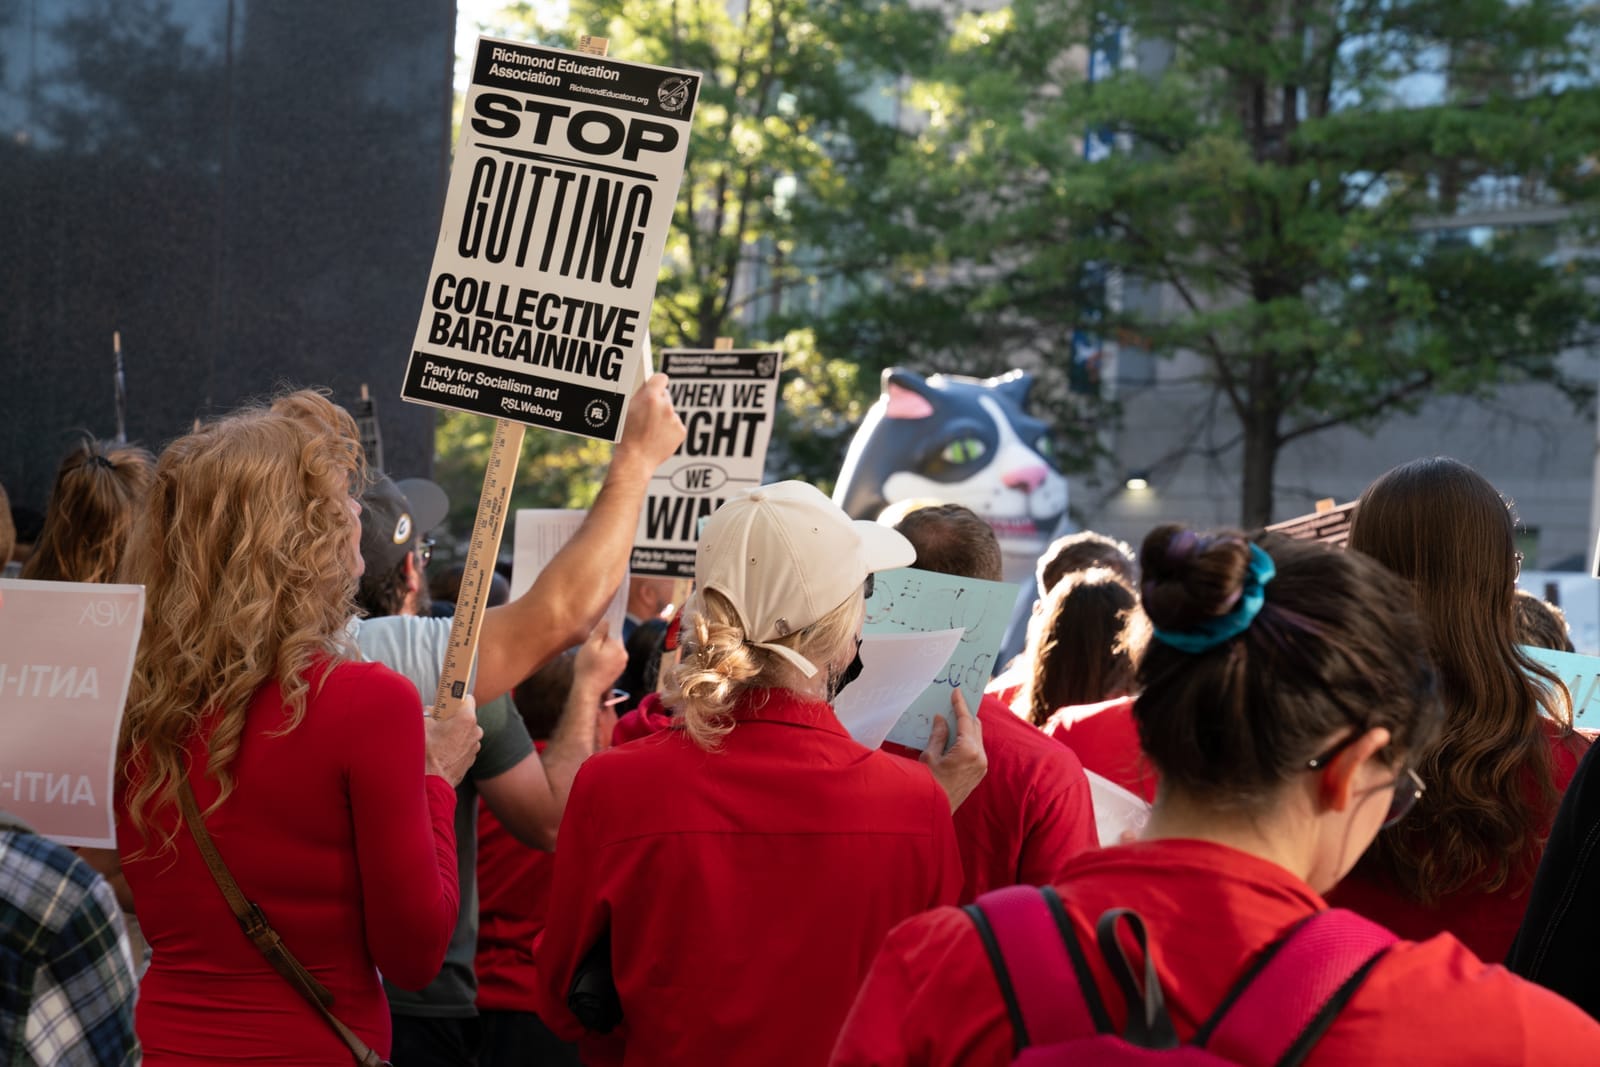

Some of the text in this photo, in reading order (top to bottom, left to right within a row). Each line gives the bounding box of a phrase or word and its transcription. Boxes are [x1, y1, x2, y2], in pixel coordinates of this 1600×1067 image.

[489, 63, 561, 87] Association
[492, 47, 620, 81] Richmond Education
[569, 83, 649, 105] RichmondEducators.org
[471, 93, 679, 162] STOP
[458, 156, 653, 289] GUTTING
[432, 273, 640, 348] COLLECTIVE
[428, 312, 625, 382] BARGAINING
[420, 376, 479, 399] Liberation
[424, 361, 560, 400] Party for Socialism and
[733, 383, 767, 408] WE
[501, 396, 562, 421] PSLWeb.org
[673, 410, 767, 458] IGHT
[686, 468, 713, 489] WE
